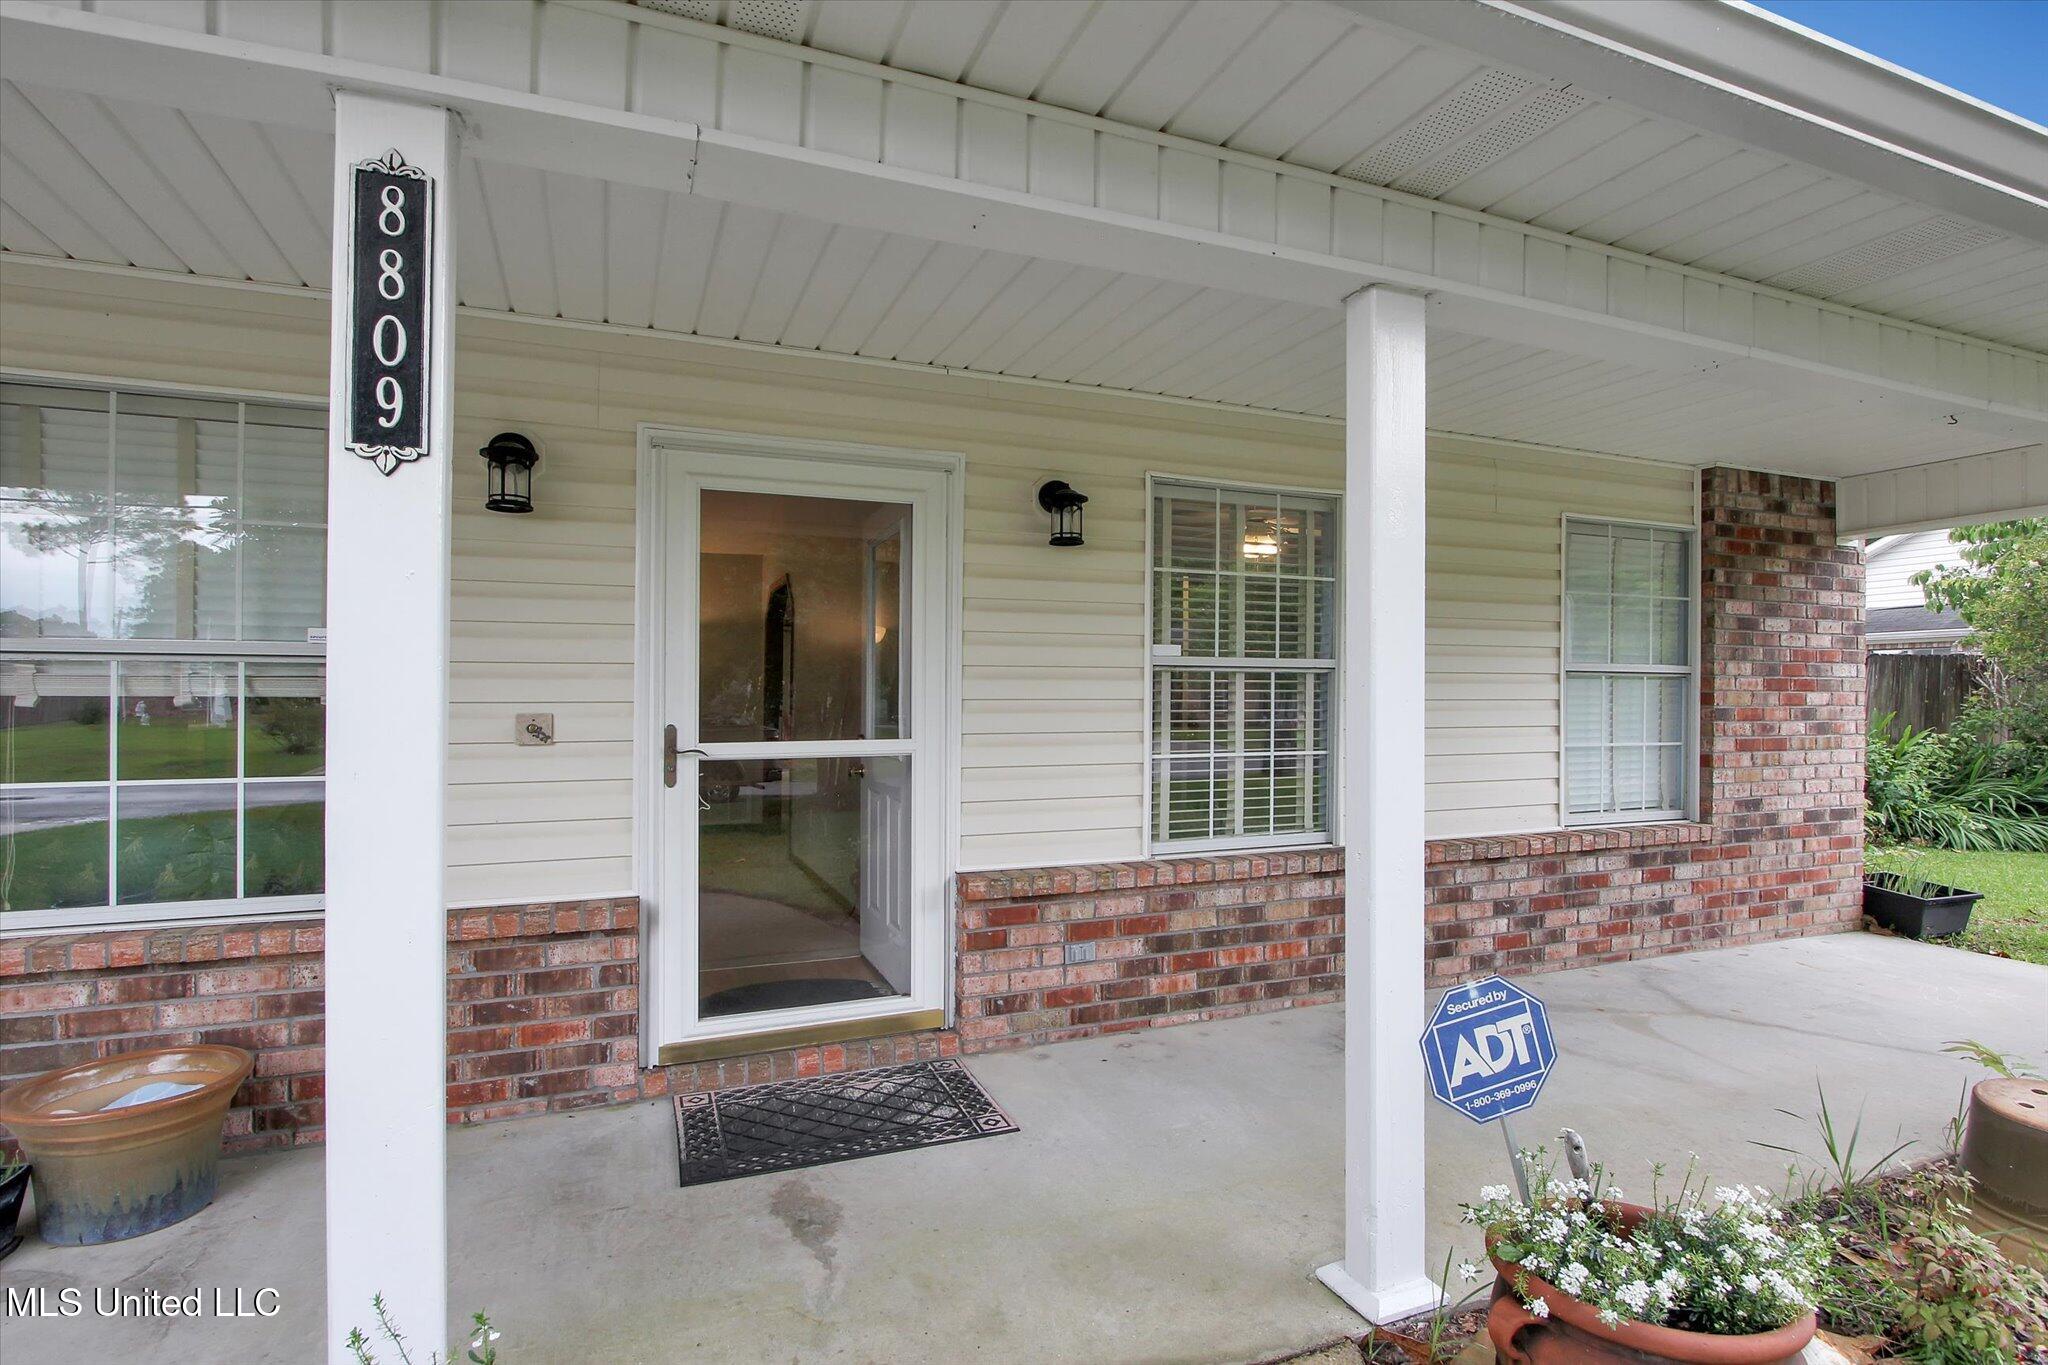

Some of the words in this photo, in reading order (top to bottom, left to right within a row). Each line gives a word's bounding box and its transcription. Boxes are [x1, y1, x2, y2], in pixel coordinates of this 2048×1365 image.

[373, 185, 408, 429] 8809
[1446, 991, 1492, 1015] Secured
[1493, 989, 1508, 1002] by
[1450, 1012, 1532, 1088] ADT
[1465, 1079, 1537, 1111] 1-800-369-0996
